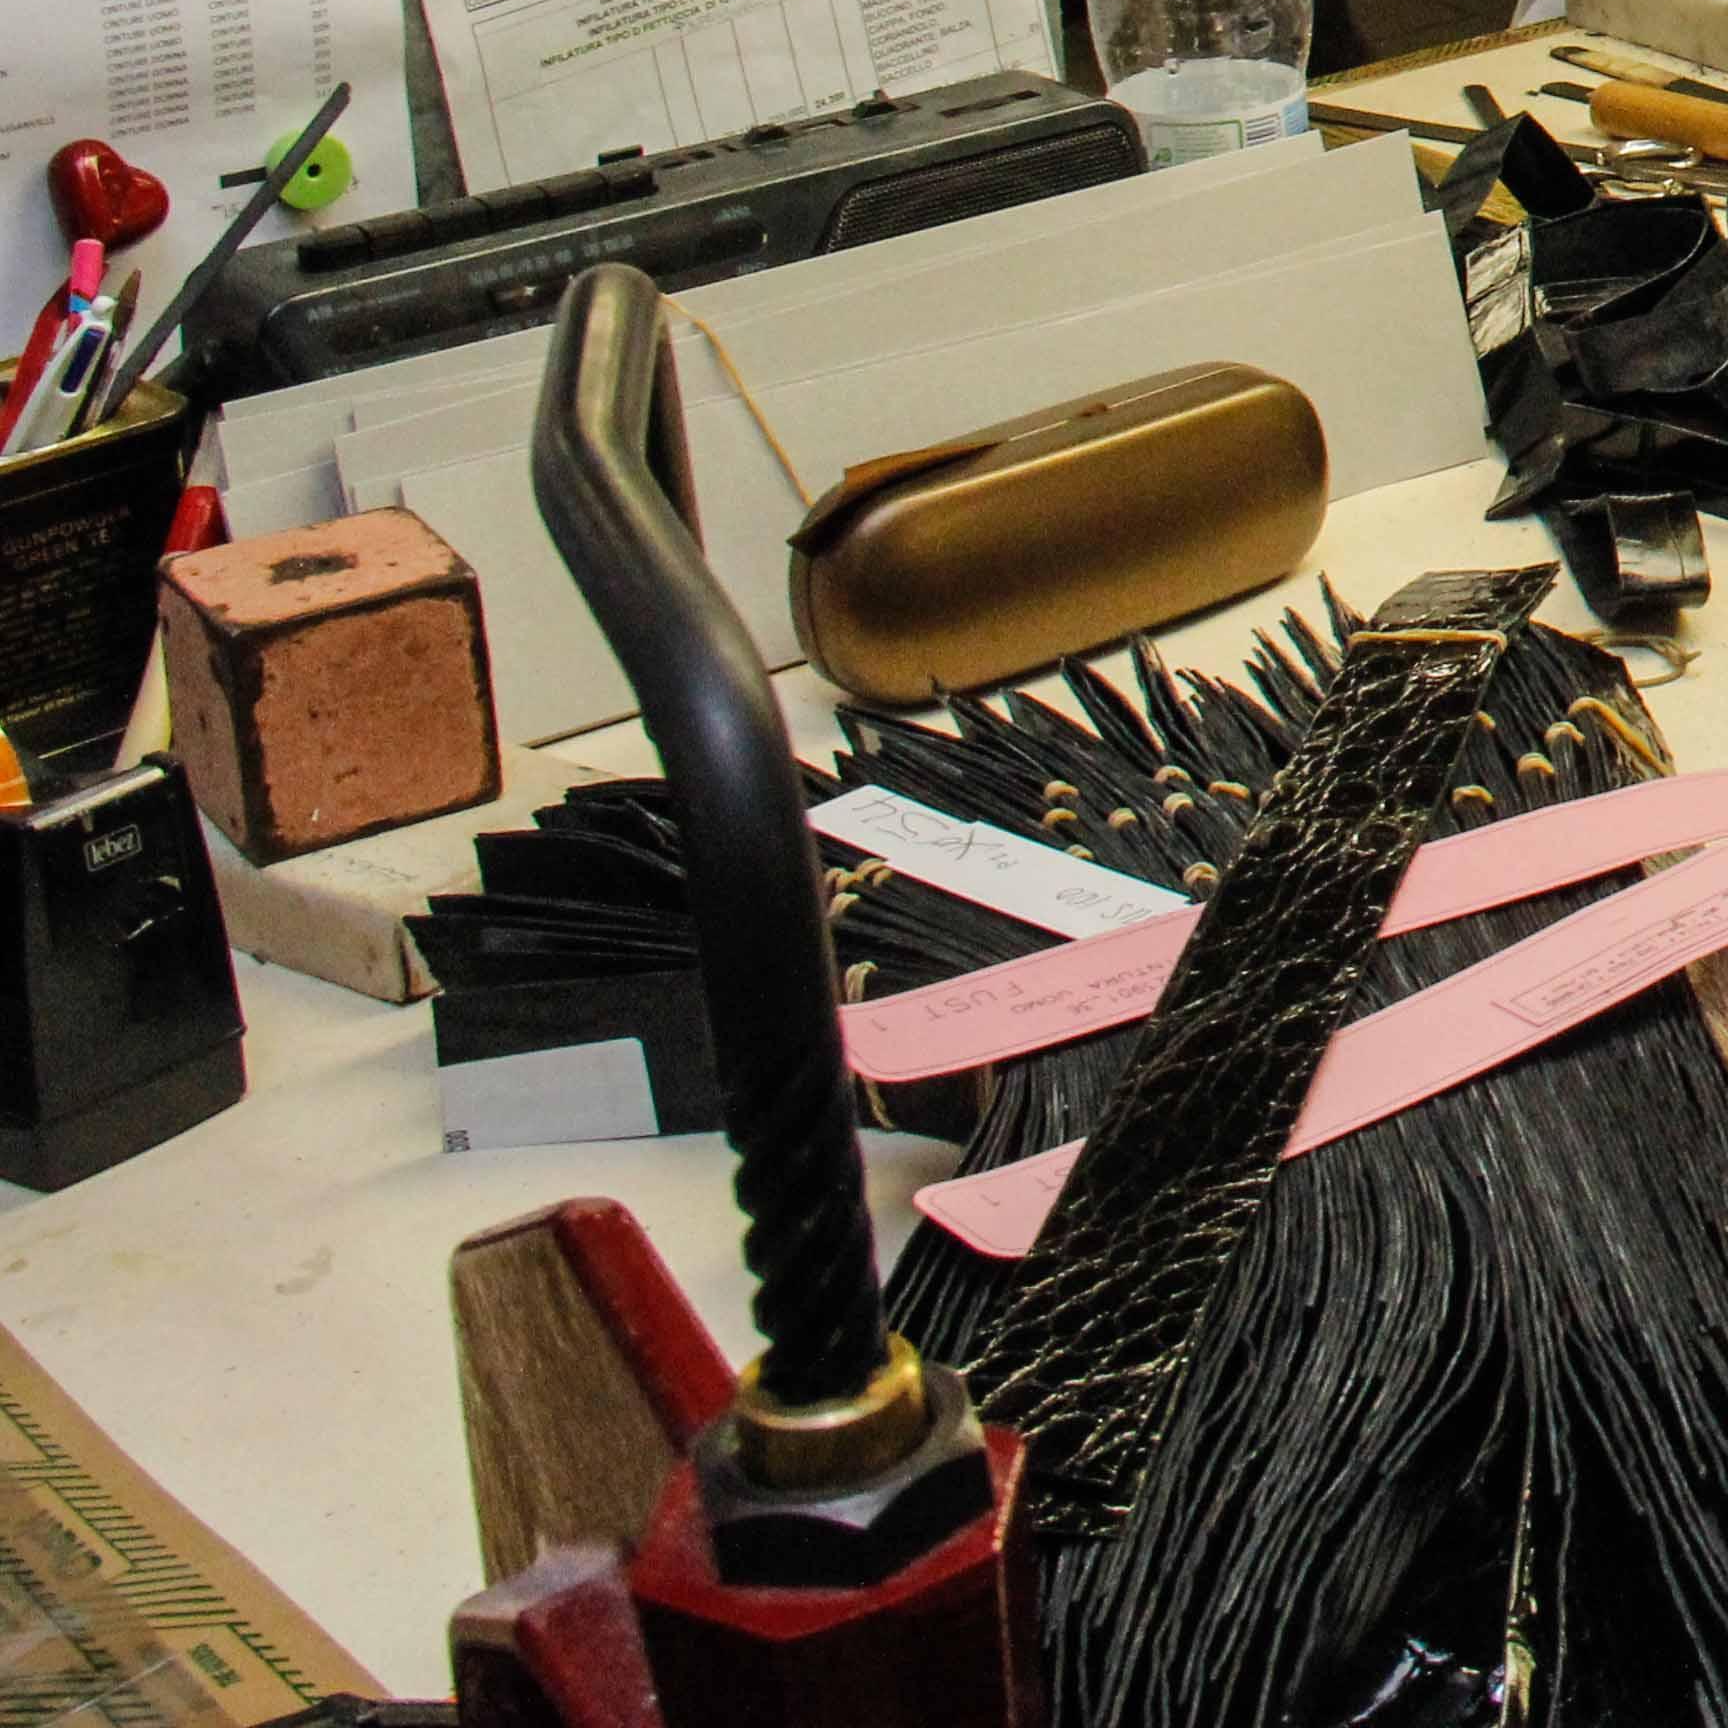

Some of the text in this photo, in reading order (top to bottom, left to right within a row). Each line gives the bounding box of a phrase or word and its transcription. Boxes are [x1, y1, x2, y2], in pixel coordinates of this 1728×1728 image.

[538, 37, 605, 68] INFILATURA
[604, 28, 631, 44] TIPO
[640, 4, 702, 32] FETTUCCIA
[585, 8, 651, 37] INFILATURA
[89, 831, 137, 865] lebez
[921, 978, 1024, 1022] FUST
